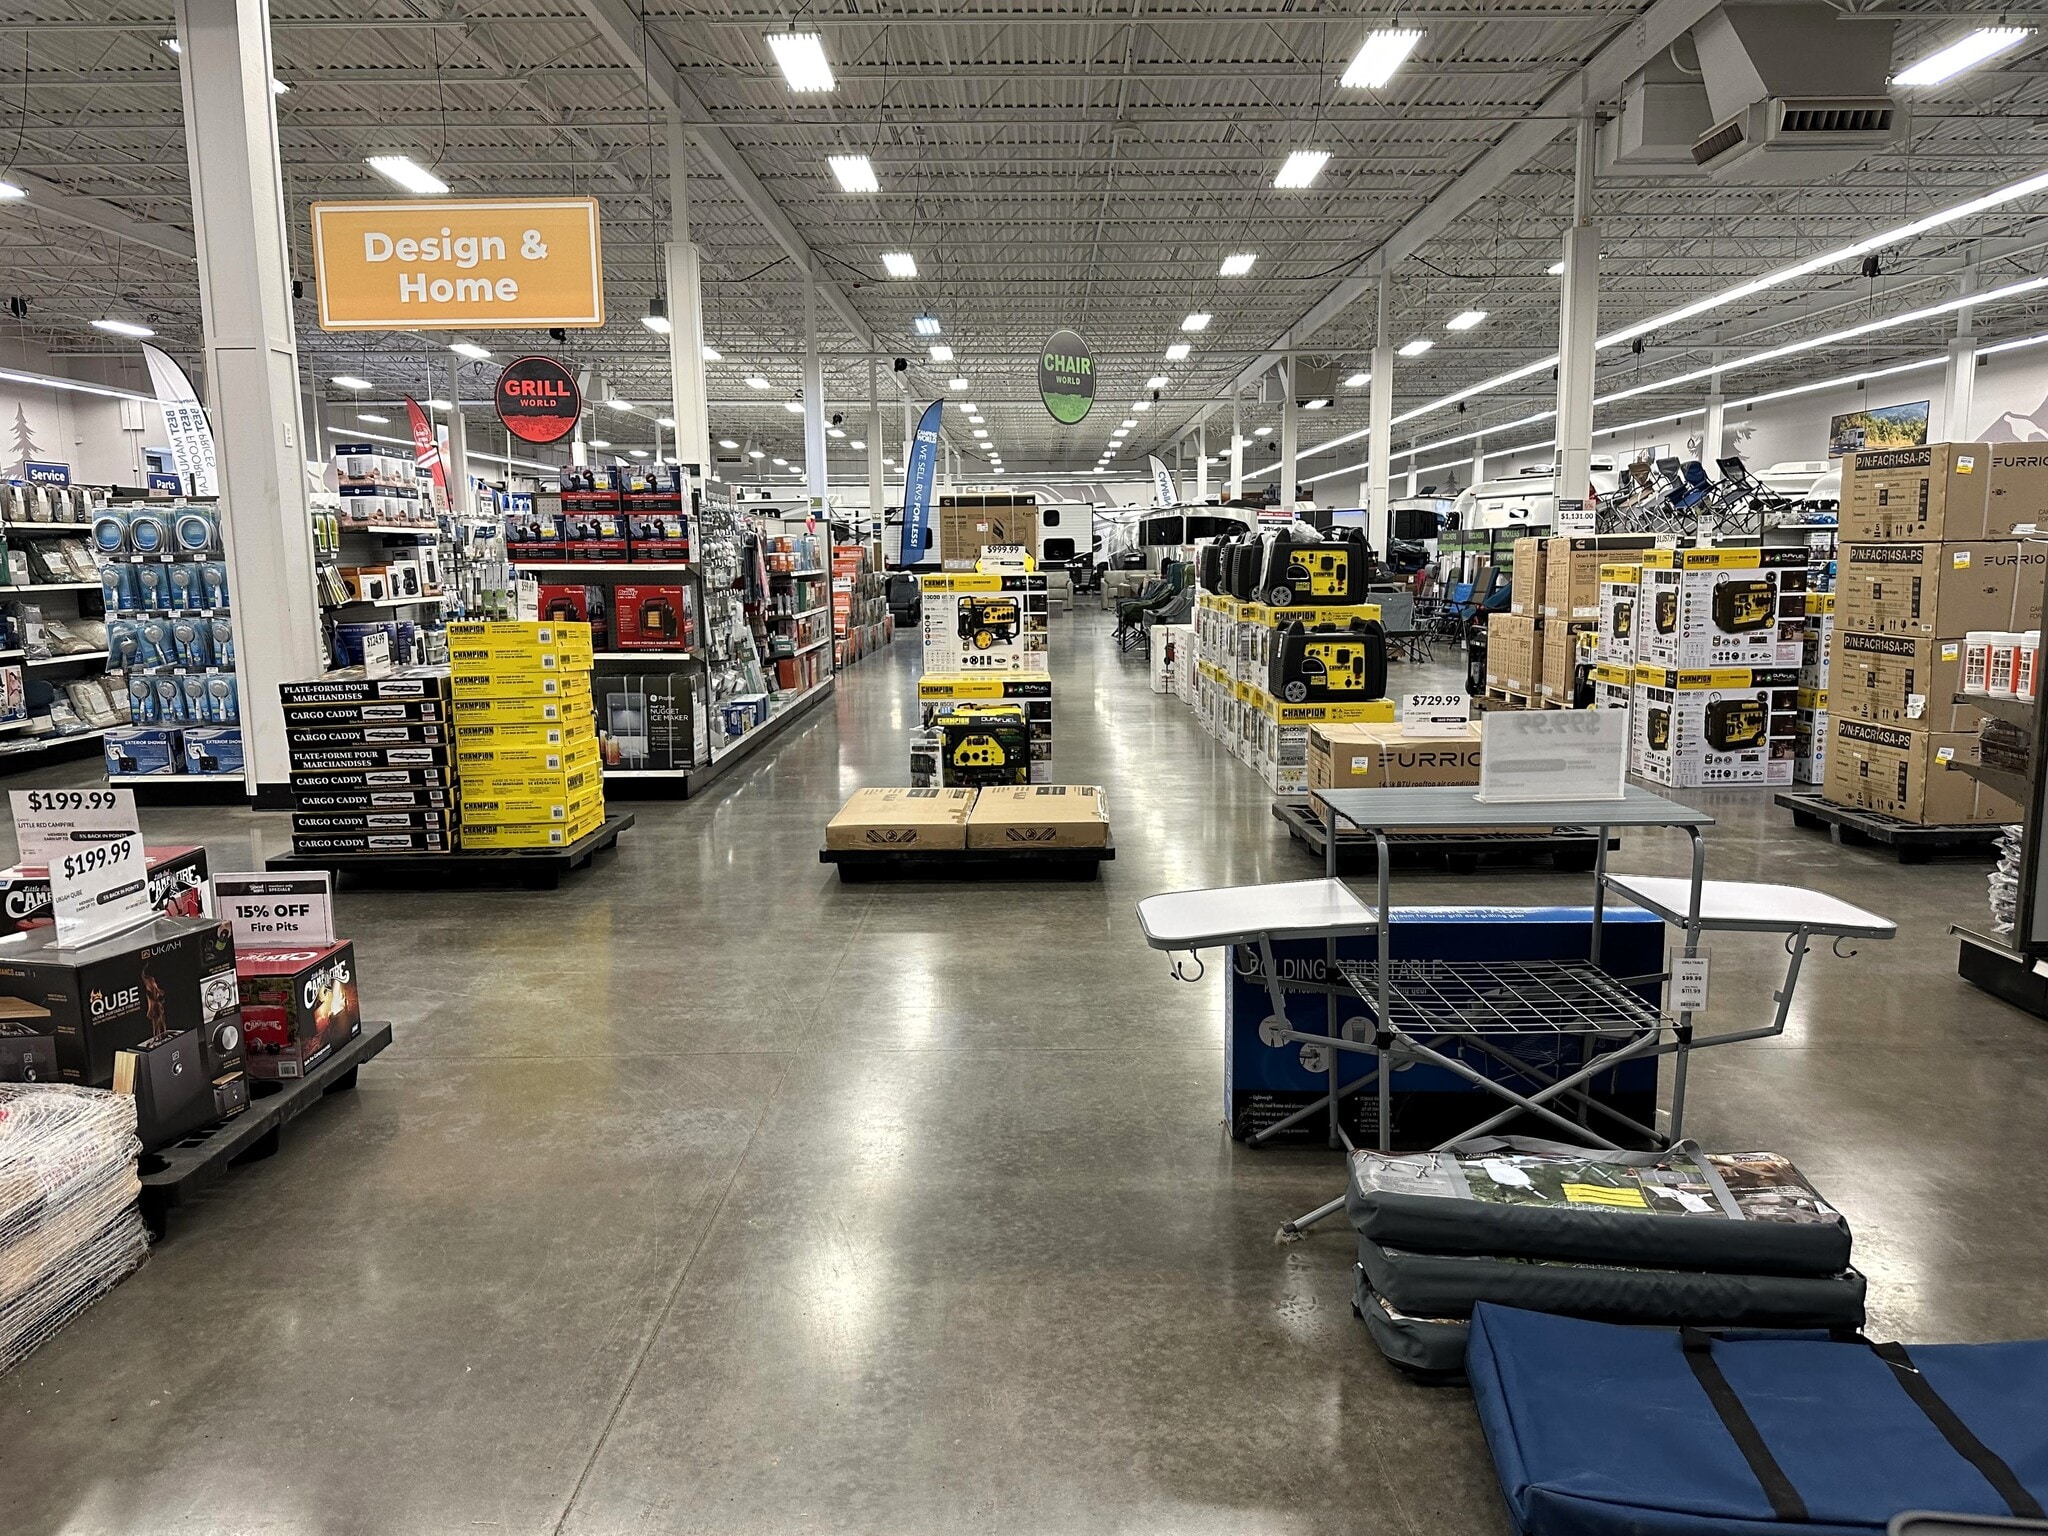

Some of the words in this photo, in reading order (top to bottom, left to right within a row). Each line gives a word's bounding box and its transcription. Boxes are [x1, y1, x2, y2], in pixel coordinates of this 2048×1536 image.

[364, 227, 506, 269] Design
[520, 229, 549, 260] &
[399, 273, 519, 303] Home
[1044, 353, 1091, 375] CHAIR
[1056, 375, 1081, 385] WORLD
[504, 379, 571, 397] GRILL
[520, 399, 557, 407] WORLD
[919, 444, 928, 460] WE
[1856, 450, 1930, 468] P/N:FACR14SA-PS
[31, 469, 66, 482] Service
[916, 462, 926, 483] SELL
[156, 478, 176, 491] Parts
[912, 502, 921, 522] FOR
[1560, 510, 1594, 520] $1,131.00
[910, 523, 919, 547] LESS!
[987, 545, 1020, 554] $999.99
[1687, 554, 1720, 564] CHAMPION
[1850, 549, 1923, 561] P/N:FACR14SA-PS
[1274, 611, 1316, 620] CHAMPION
[450, 625, 485, 634] CHAMPION
[366, 634, 385, 648] $124.99
[1844, 635, 1915, 654] P/N:FACR14SA-PS
[453, 650, 489, 659] CHAMPION
[454, 675, 490, 685] CHAMPION
[1679, 675, 1712, 684] CHAMPION
[284, 685, 344, 693] PLATE-FORME
[921, 686, 954, 695] CHAMPION
[293, 693, 363, 702] MARCHANDISES
[1412, 695, 1461, 707] $729.99
[455, 701, 491, 710] CHAMPION
[291, 711, 324, 720] CARGO
[326, 710, 359, 718] CADDY
[1282, 708, 1326, 717] CHAMPION
[937, 717, 970, 726] CHAMPION
[458, 726, 494, 737] CHAMPION
[1839, 723, 1911, 747] P/N:FACR14SA-PS
[293, 734, 327, 742] CARGO
[329, 732, 361, 740] CADDY
[294, 752, 354, 760] PLATE-FORME
[458, 751, 494, 761] CHAMPION
[303, 760, 372, 769] MARCHANDISES
[296, 777, 329, 786] CARGO
[331, 776, 363, 784] CADDY
[1396, 780, 1410, 788] BTU
[28, 790, 117, 813] $199.99
[302, 797, 334, 805] CARGO
[336, 796, 368, 804] CADDY
[463, 802, 499, 811] CHAMPION
[298, 818, 330, 826] CARGO
[332, 817, 364, 825] CADDY
[463, 826, 498, 835] CHAMPION
[298, 840, 331, 848] CARGO
[333, 839, 365, 848] CADDY
[64, 840, 131, 880] $199.99
[235, 905, 270, 918] 15%
[274, 904, 310, 917] OFF
[250, 923, 273, 932] Fire
[276, 921, 299, 931] Pits
[90, 986, 140, 1015] QUBE
